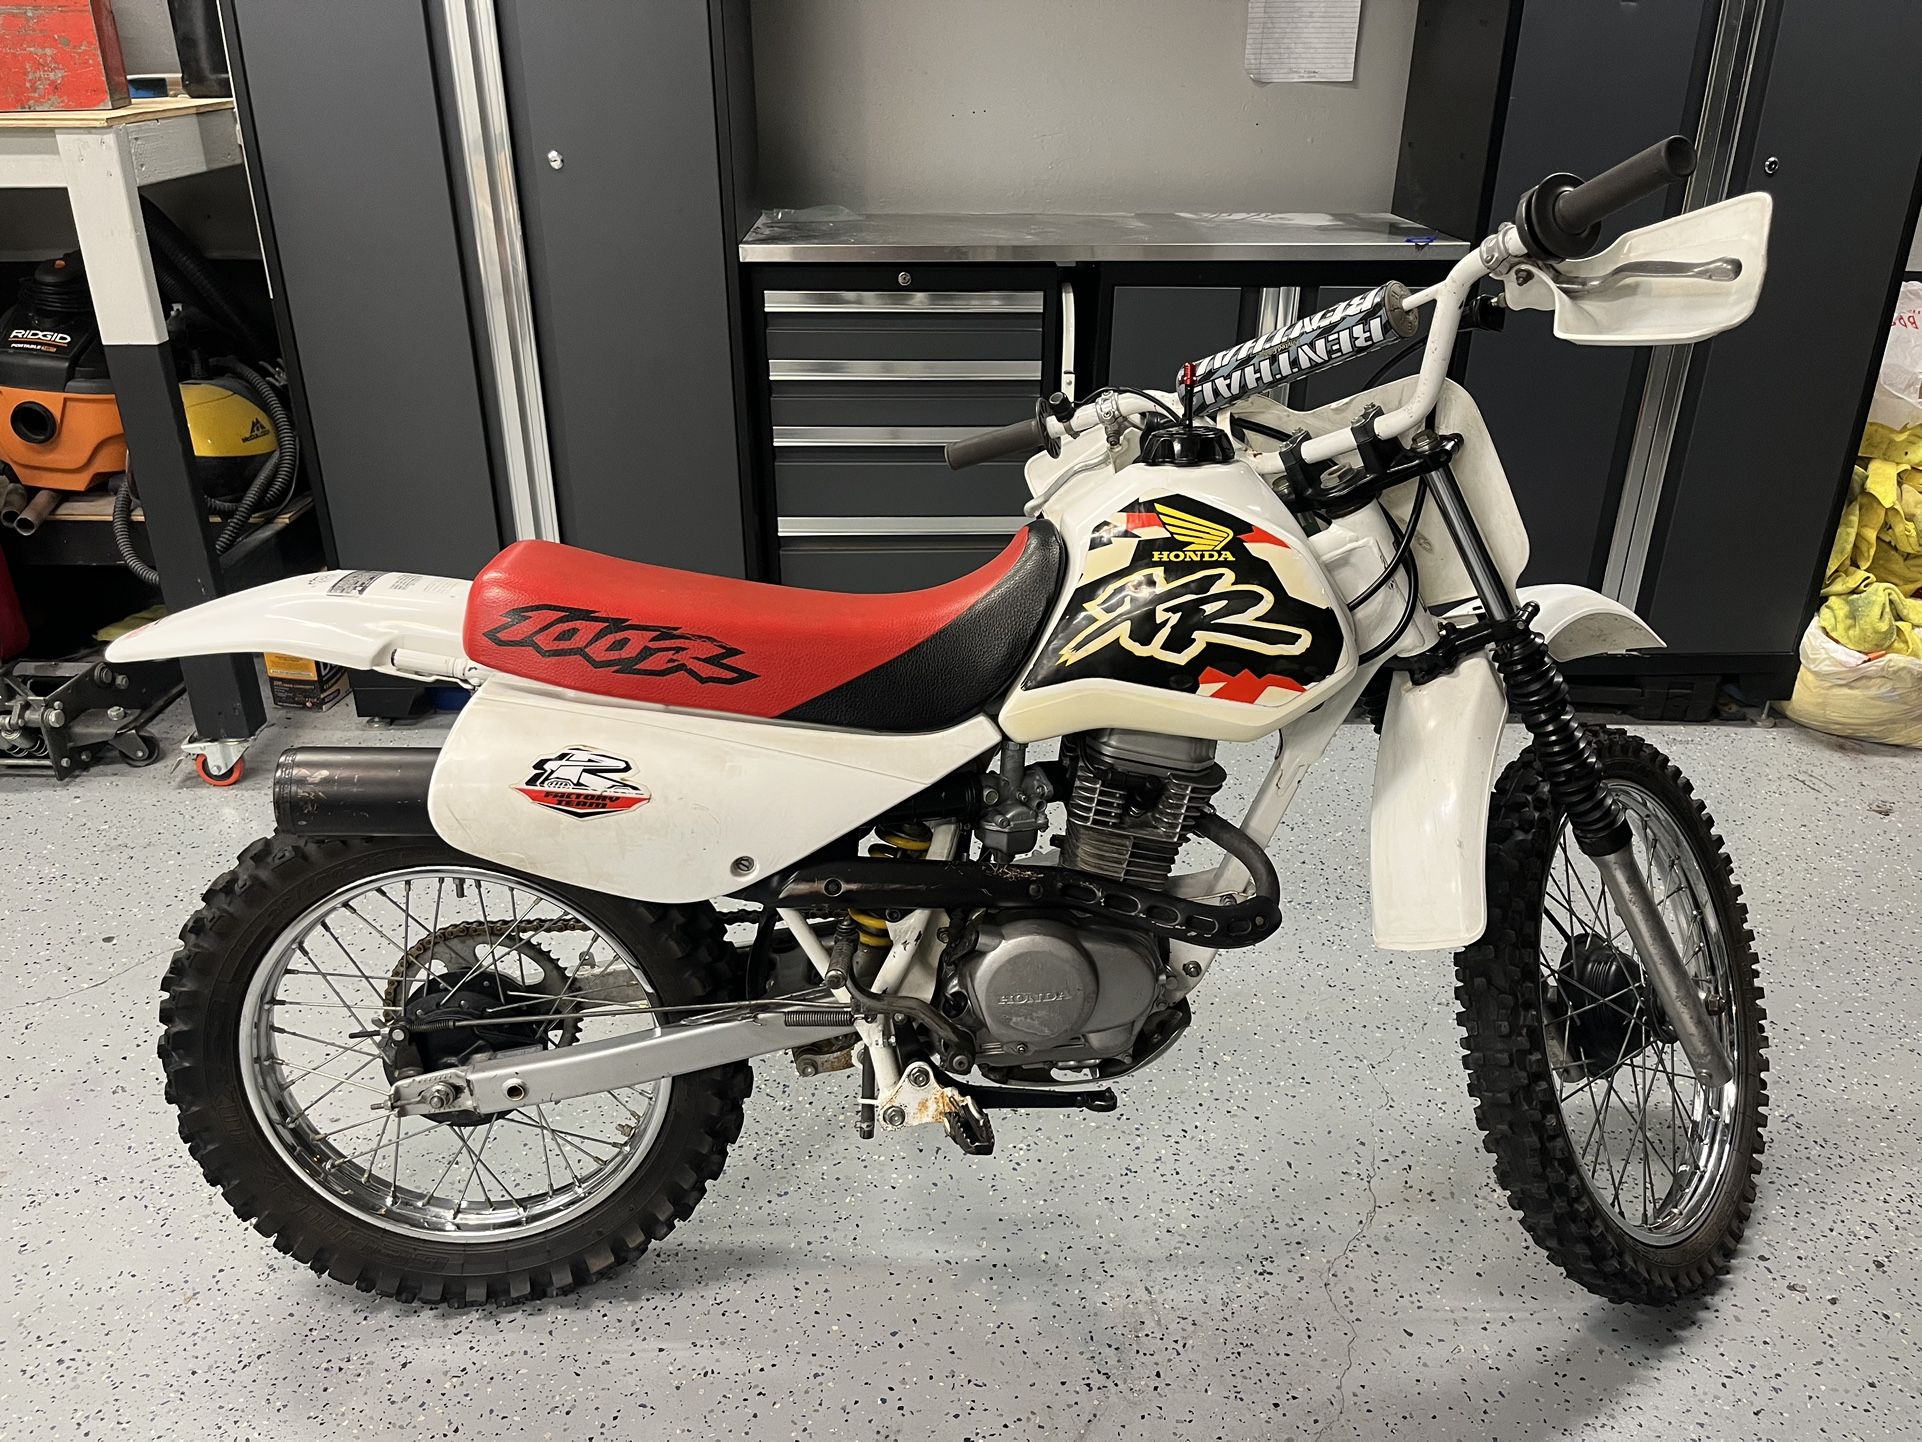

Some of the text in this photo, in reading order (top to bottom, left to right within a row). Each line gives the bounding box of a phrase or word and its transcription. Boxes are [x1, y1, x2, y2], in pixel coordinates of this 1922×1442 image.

[9, 329, 72, 344] RIDGID
[1195, 288, 1380, 376] RENTHAL
[1193, 316, 1386, 406] RENTHAL
[1151, 550, 1236, 562] HONDA
[1056, 566, 1313, 666] XR
[483, 603, 761, 685] 100R
[543, 791, 621, 803] FACTORY
[555, 799, 609, 809] TEAM
[997, 991, 1073, 1005] HONDA
